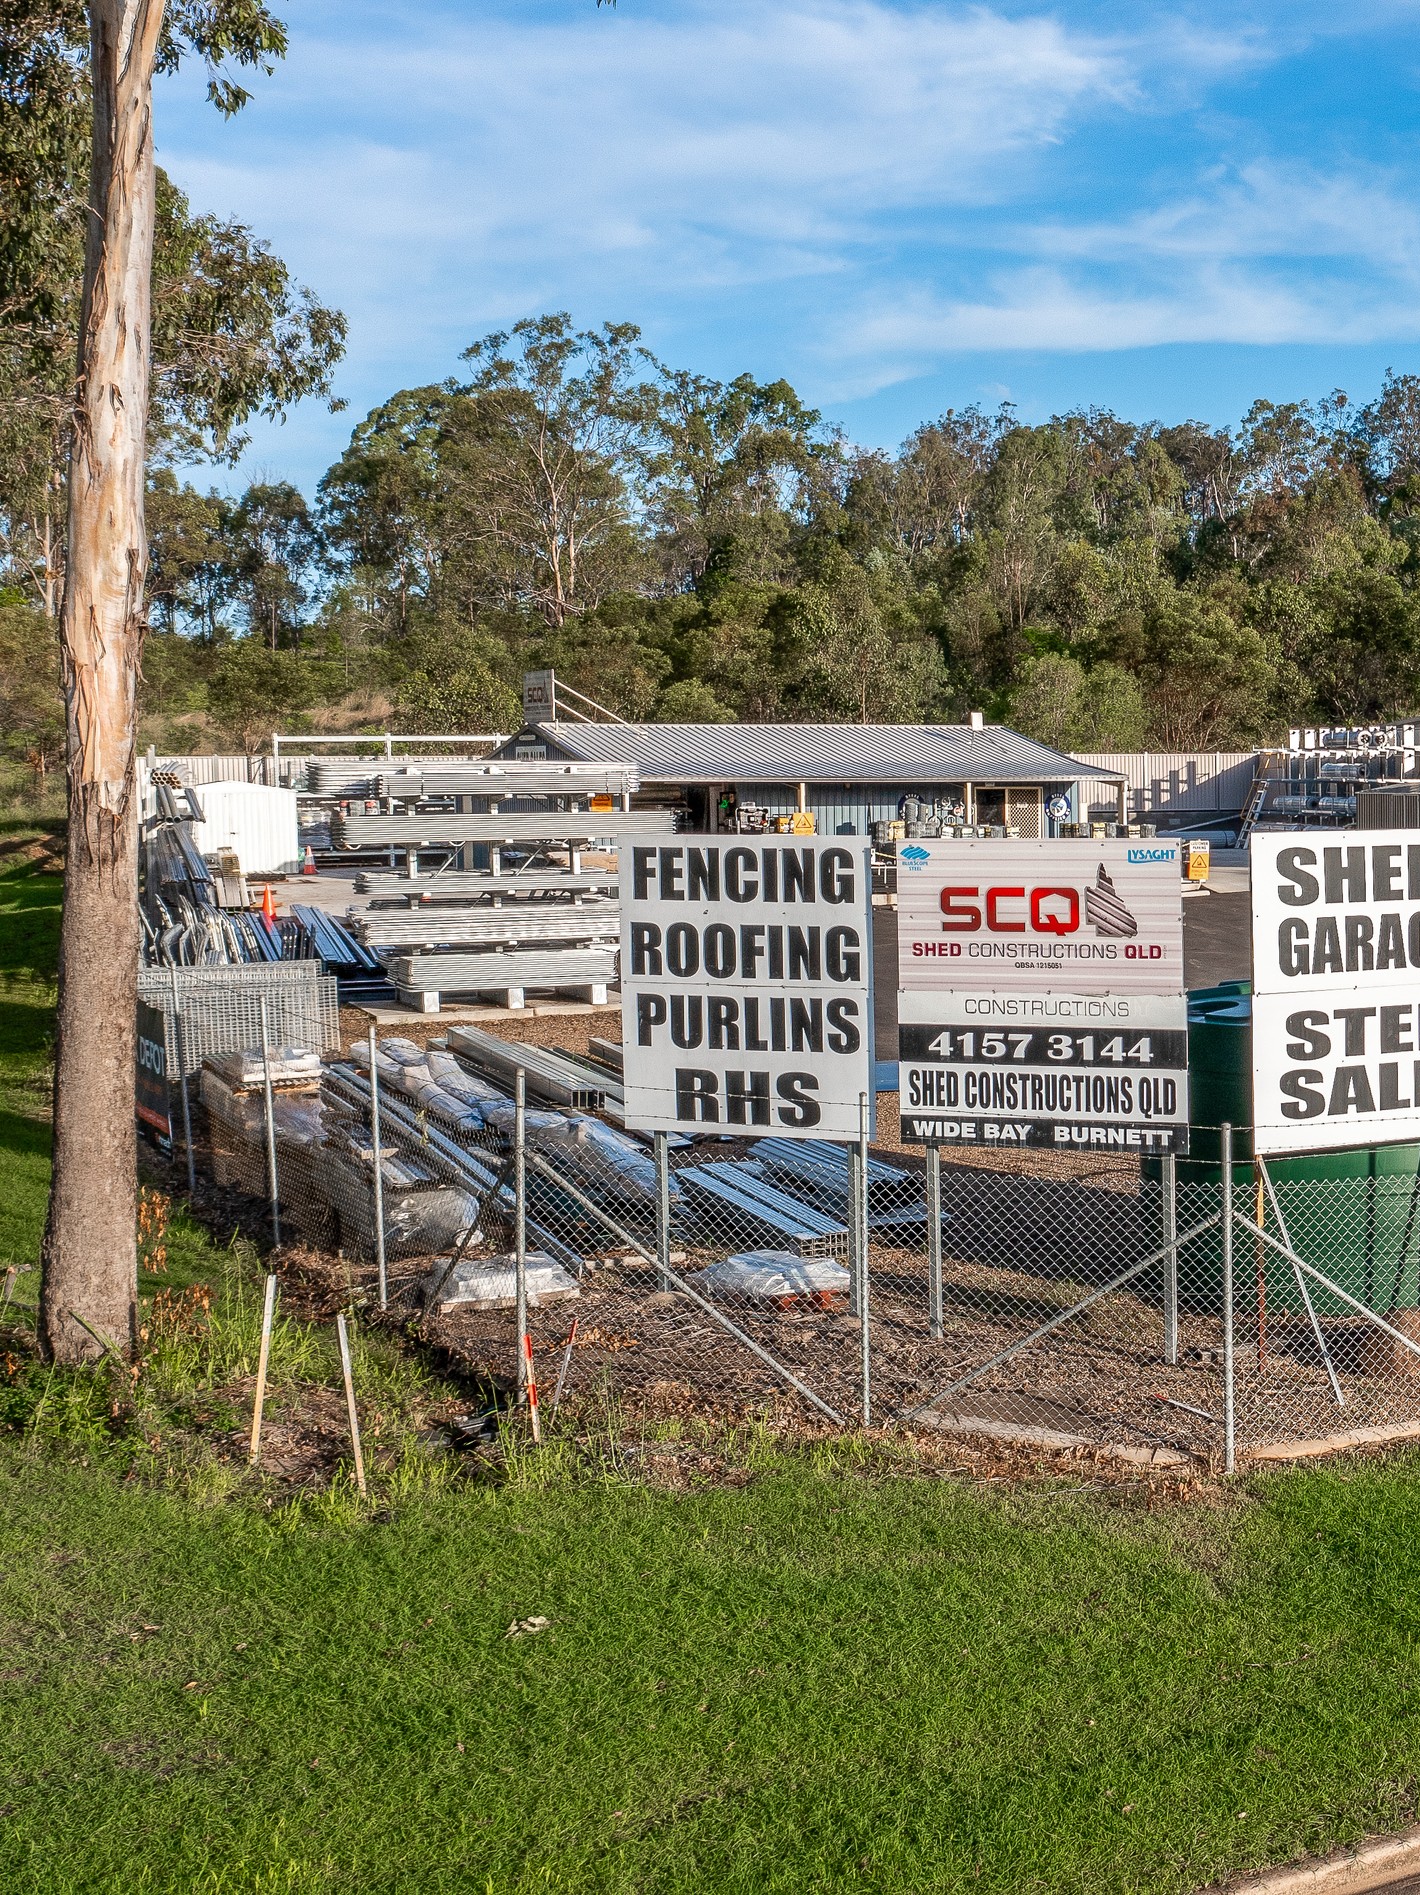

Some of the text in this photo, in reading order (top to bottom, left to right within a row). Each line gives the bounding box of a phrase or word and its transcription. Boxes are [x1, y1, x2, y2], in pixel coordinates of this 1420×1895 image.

[527, 686, 543, 703] SCQ
[633, 846, 855, 905] FENCING
[1127, 849, 1176, 864] LYSAGHT
[939, 886, 1081, 937] SCQ
[630, 921, 861, 982] ROOFING
[911, 942, 962, 958] SHED
[968, 943, 1118, 960] CONSTRUCTIONS
[1124, 944, 1162, 960] QLD
[636, 993, 861, 1055] PURLINS
[964, 999, 1130, 1017] CONSTRUCTIONS
[139, 1035, 165, 1077] DEPOT
[928, 1031, 1154, 1063] 4157 3144
[675, 1067, 822, 1128] RHS
[908, 1068, 1177, 1119] SHED CONSTRUCTIONS QLD
[913, 1119, 1173, 1146] WIDE BAY BURNETT
